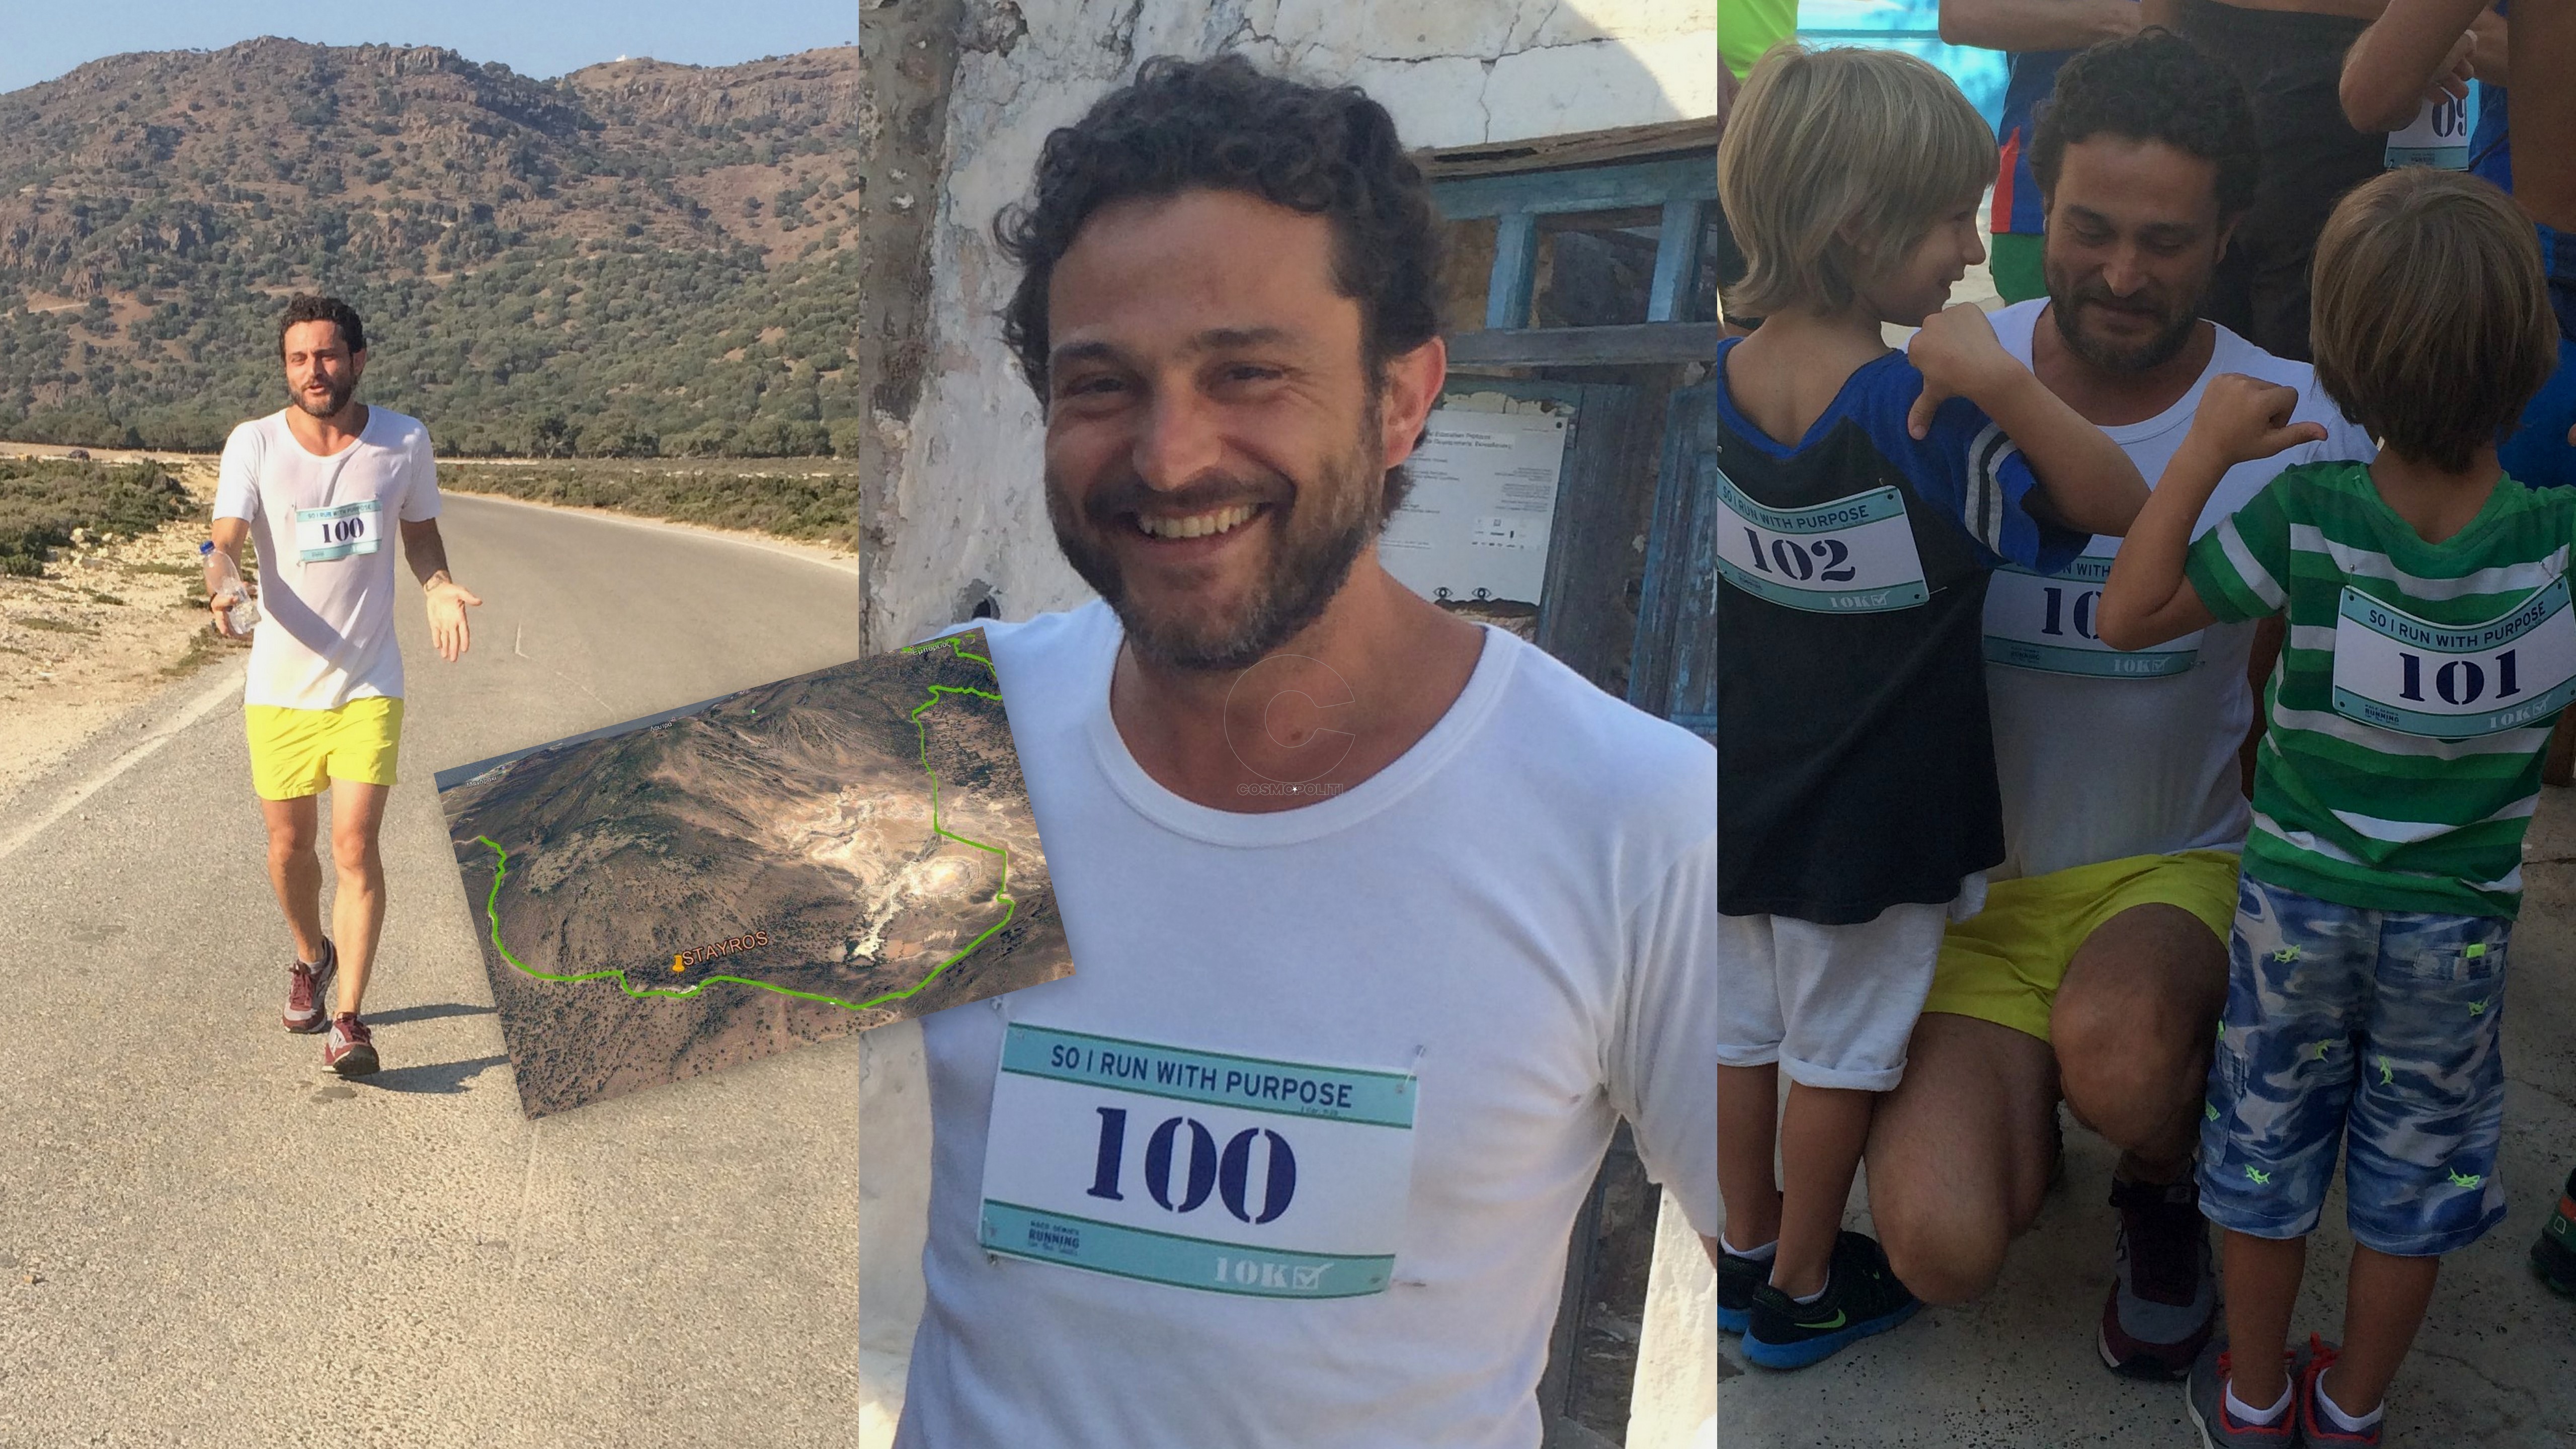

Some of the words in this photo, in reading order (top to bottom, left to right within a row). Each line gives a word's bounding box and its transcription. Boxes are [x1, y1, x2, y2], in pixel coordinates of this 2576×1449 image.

[1723, 486, 1732, 502] SO
[1734, 495, 1737, 504] I
[1739, 499, 1758, 521] RUN
[1761, 513, 1793, 529] WITH
[1797, 505, 1869, 529] PURPOSE
[322, 517, 364, 543] 100
[1743, 526, 1856, 582] 102
[2077, 564, 2111, 577] WITH
[1829, 596, 1873, 608] 10K
[2042, 587, 2103, 639] 10
[2369, 609, 2386, 627] SO
[2390, 619, 2394, 632] I
[2399, 623, 2431, 644] RUN
[2436, 634, 2478, 648] WITH
[2484, 601, 2546, 644] PURPOSE
[2113, 659, 2151, 673] 10K
[2399, 649, 2521, 705] 101
[2490, 704, 2531, 729] 10K
[1051, 1044, 1080, 1070] SO
[1086, 1048, 1092, 1072] I
[1101, 1052, 1148, 1080] RUN
[1157, 1061, 1217, 1091] WITH
[1226, 1072, 1353, 1109] PURPOSE
[1086, 1106, 1297, 1226] 100
[1029, 1228, 1080, 1249] RUNNING
[1214, 1256, 1289, 1290] 10K
